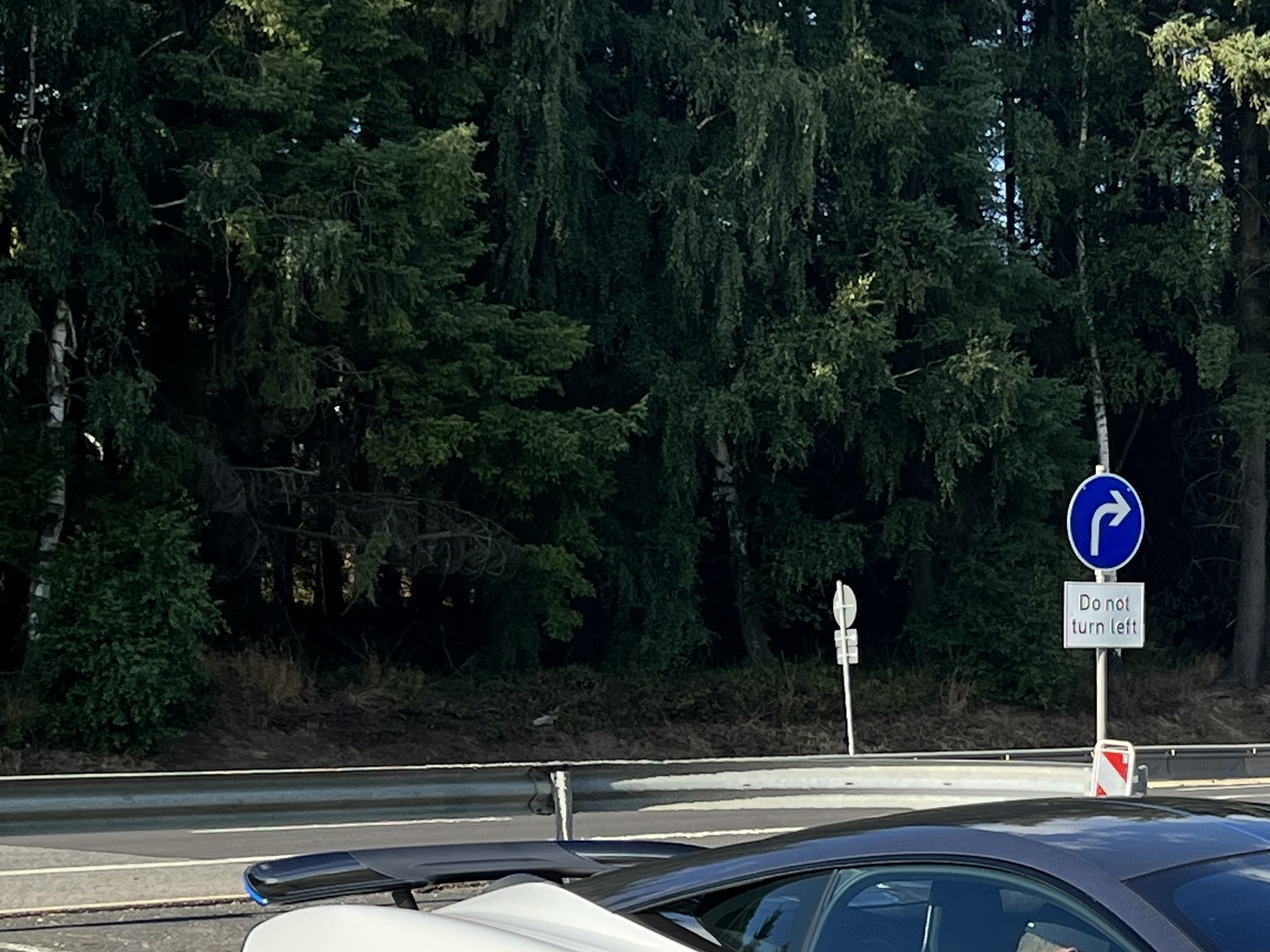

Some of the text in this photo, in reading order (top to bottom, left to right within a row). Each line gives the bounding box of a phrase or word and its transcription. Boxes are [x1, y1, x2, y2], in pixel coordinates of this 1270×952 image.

[1079, 594, 1130, 611] Do not
[1072, 618, 1137, 635] turn left
